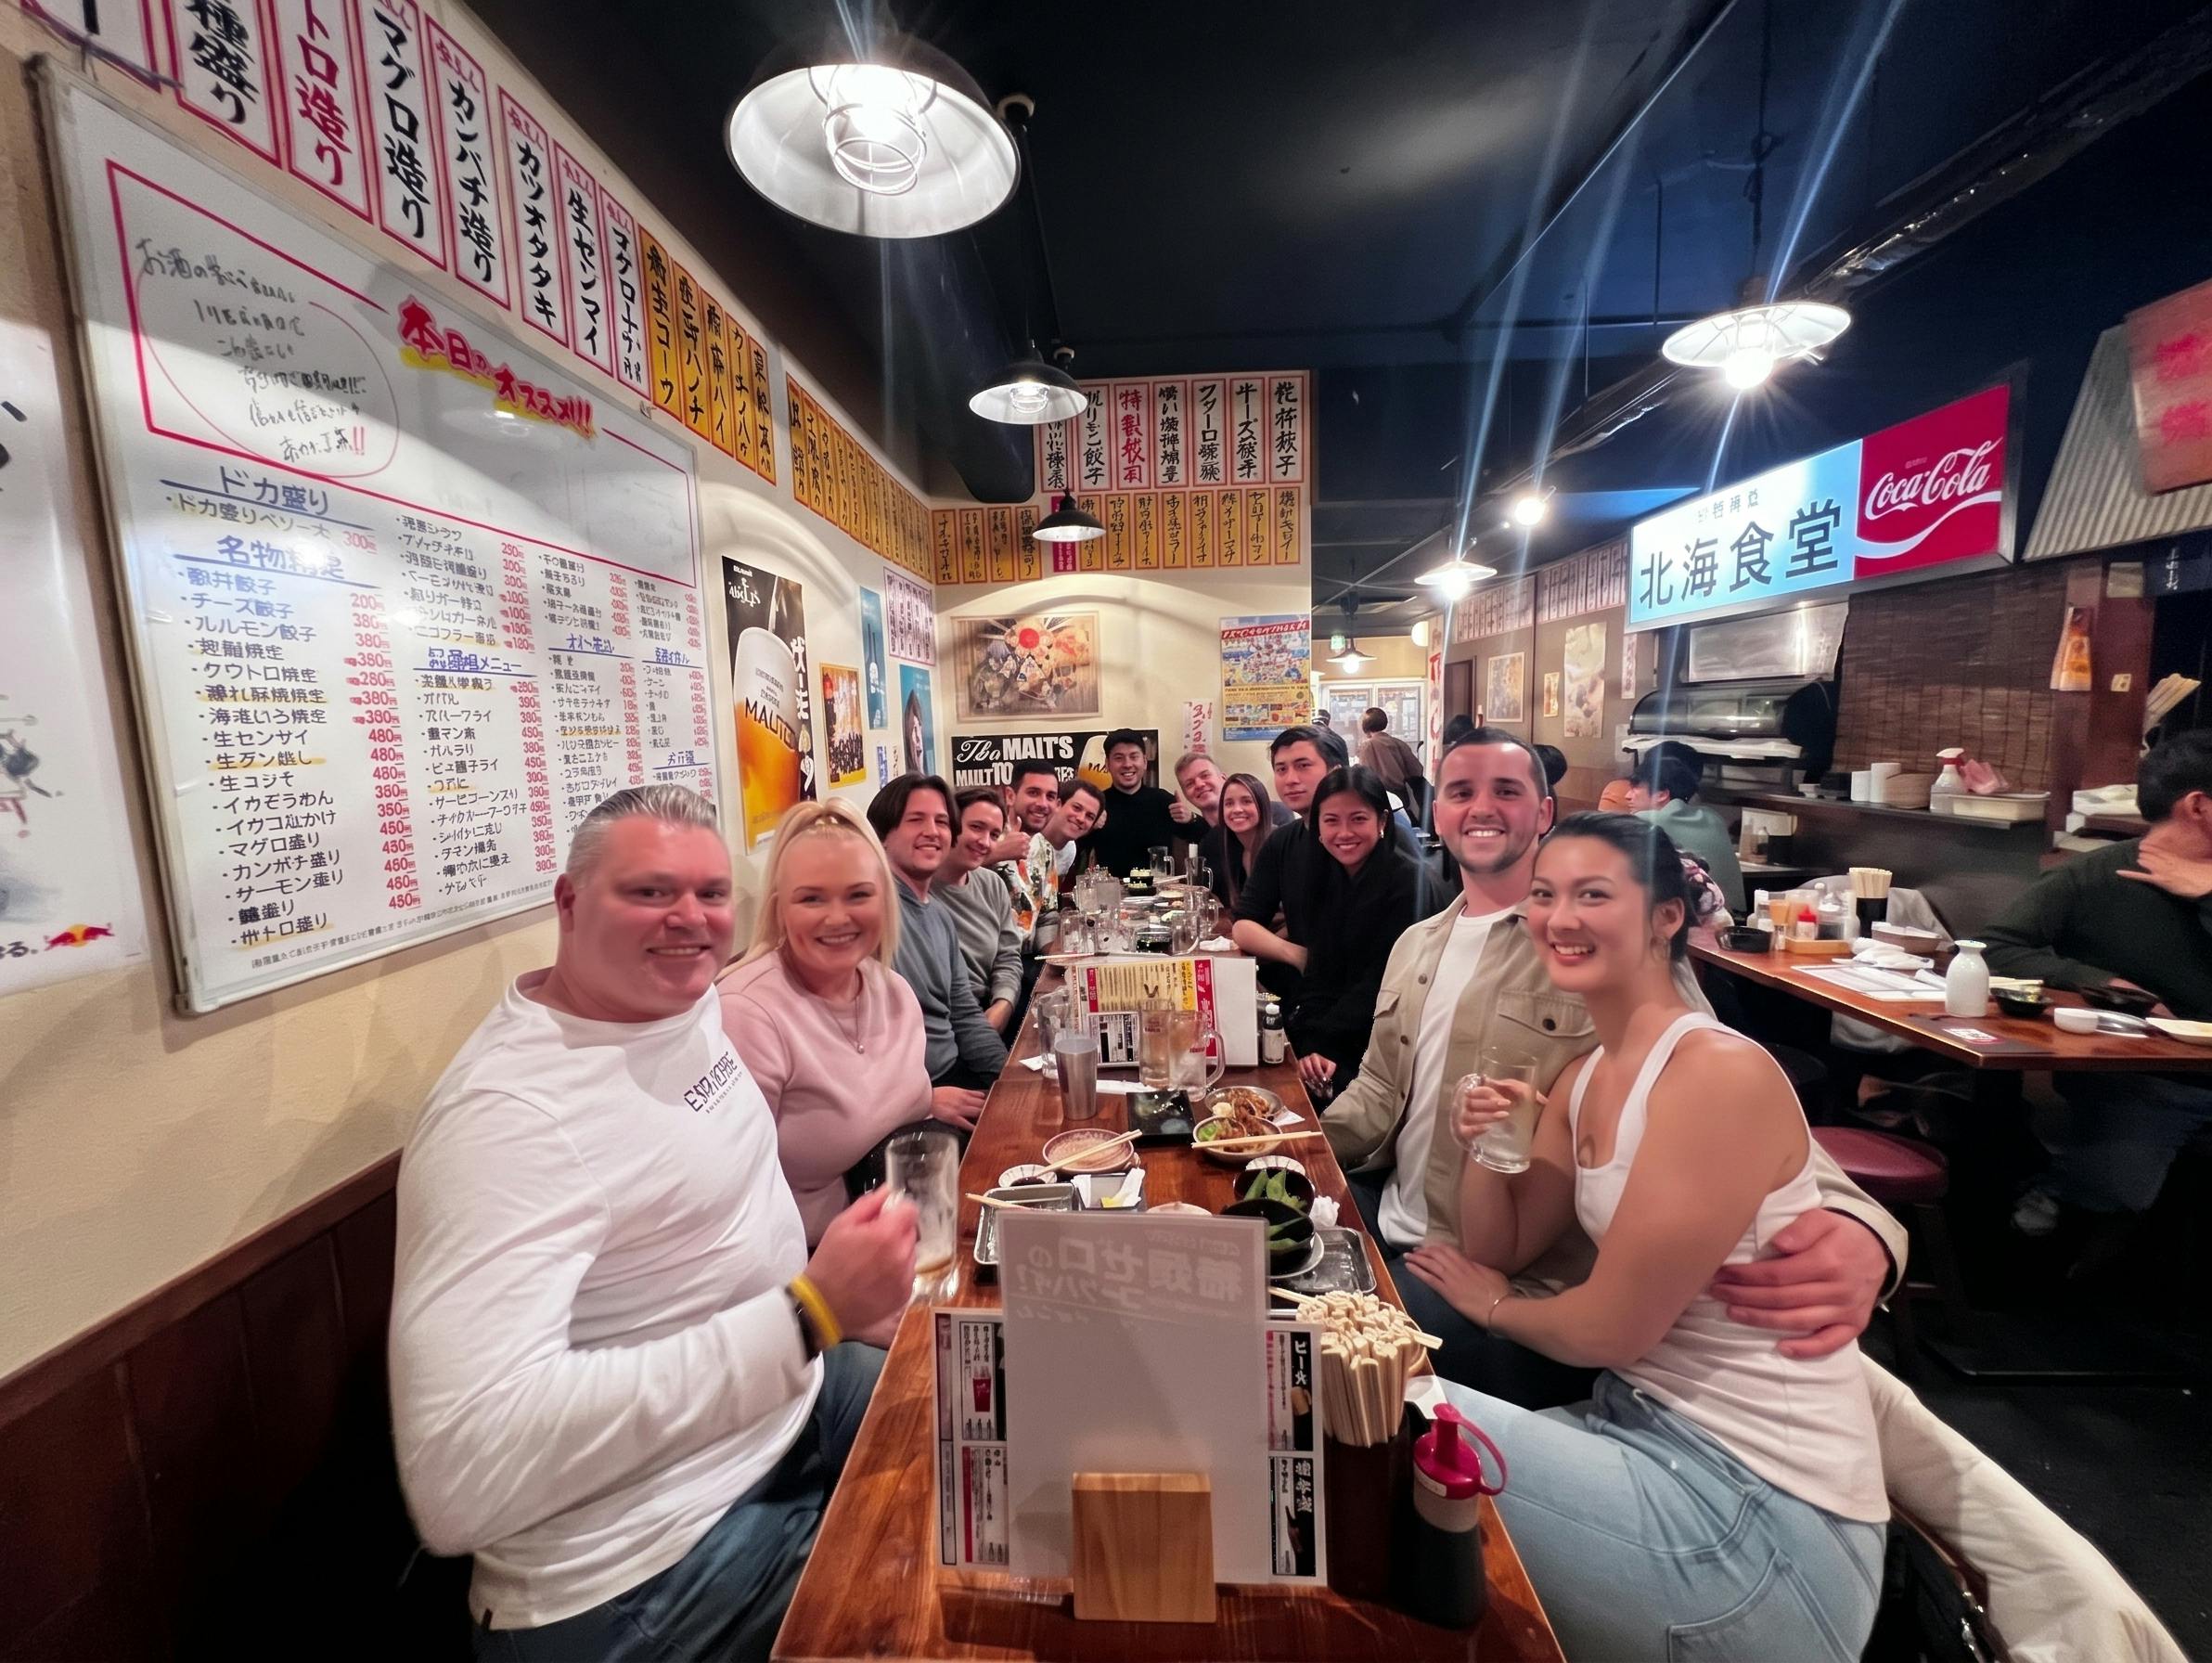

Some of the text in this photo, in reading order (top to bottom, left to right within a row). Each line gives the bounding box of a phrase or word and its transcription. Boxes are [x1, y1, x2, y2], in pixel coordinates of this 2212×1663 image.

[220, 466, 329, 515] ドカ盛り
[1864, 437, 2003, 521] Coca-Cola
[1640, 498, 1842, 610] 北海食堂
